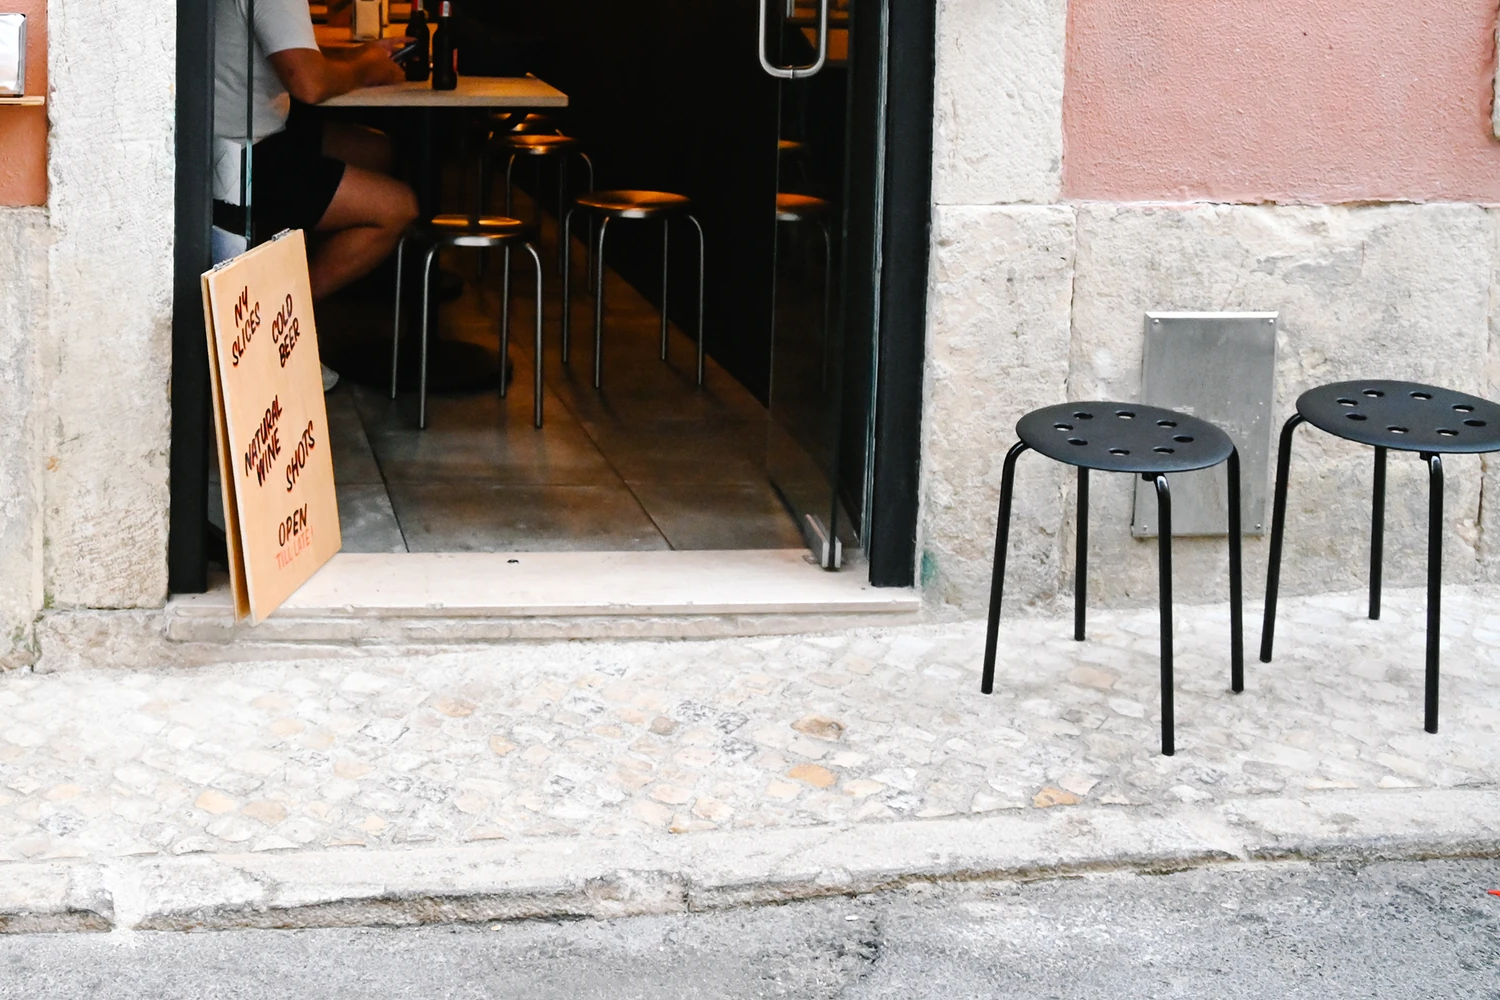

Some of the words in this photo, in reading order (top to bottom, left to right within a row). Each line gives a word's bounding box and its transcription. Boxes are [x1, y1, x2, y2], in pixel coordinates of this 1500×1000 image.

[234, 285, 249, 329] NY
[271, 293, 293, 344] COLD
[232, 301, 261, 368] SLICES
[278, 316, 301, 368] BEER
[244, 394, 283, 477] NATURAL
[256, 427, 282, 488] WINE
[285, 419, 316, 493] SHOTS
[278, 502, 308, 547] OPEN
[275, 545, 294, 570] TILL
